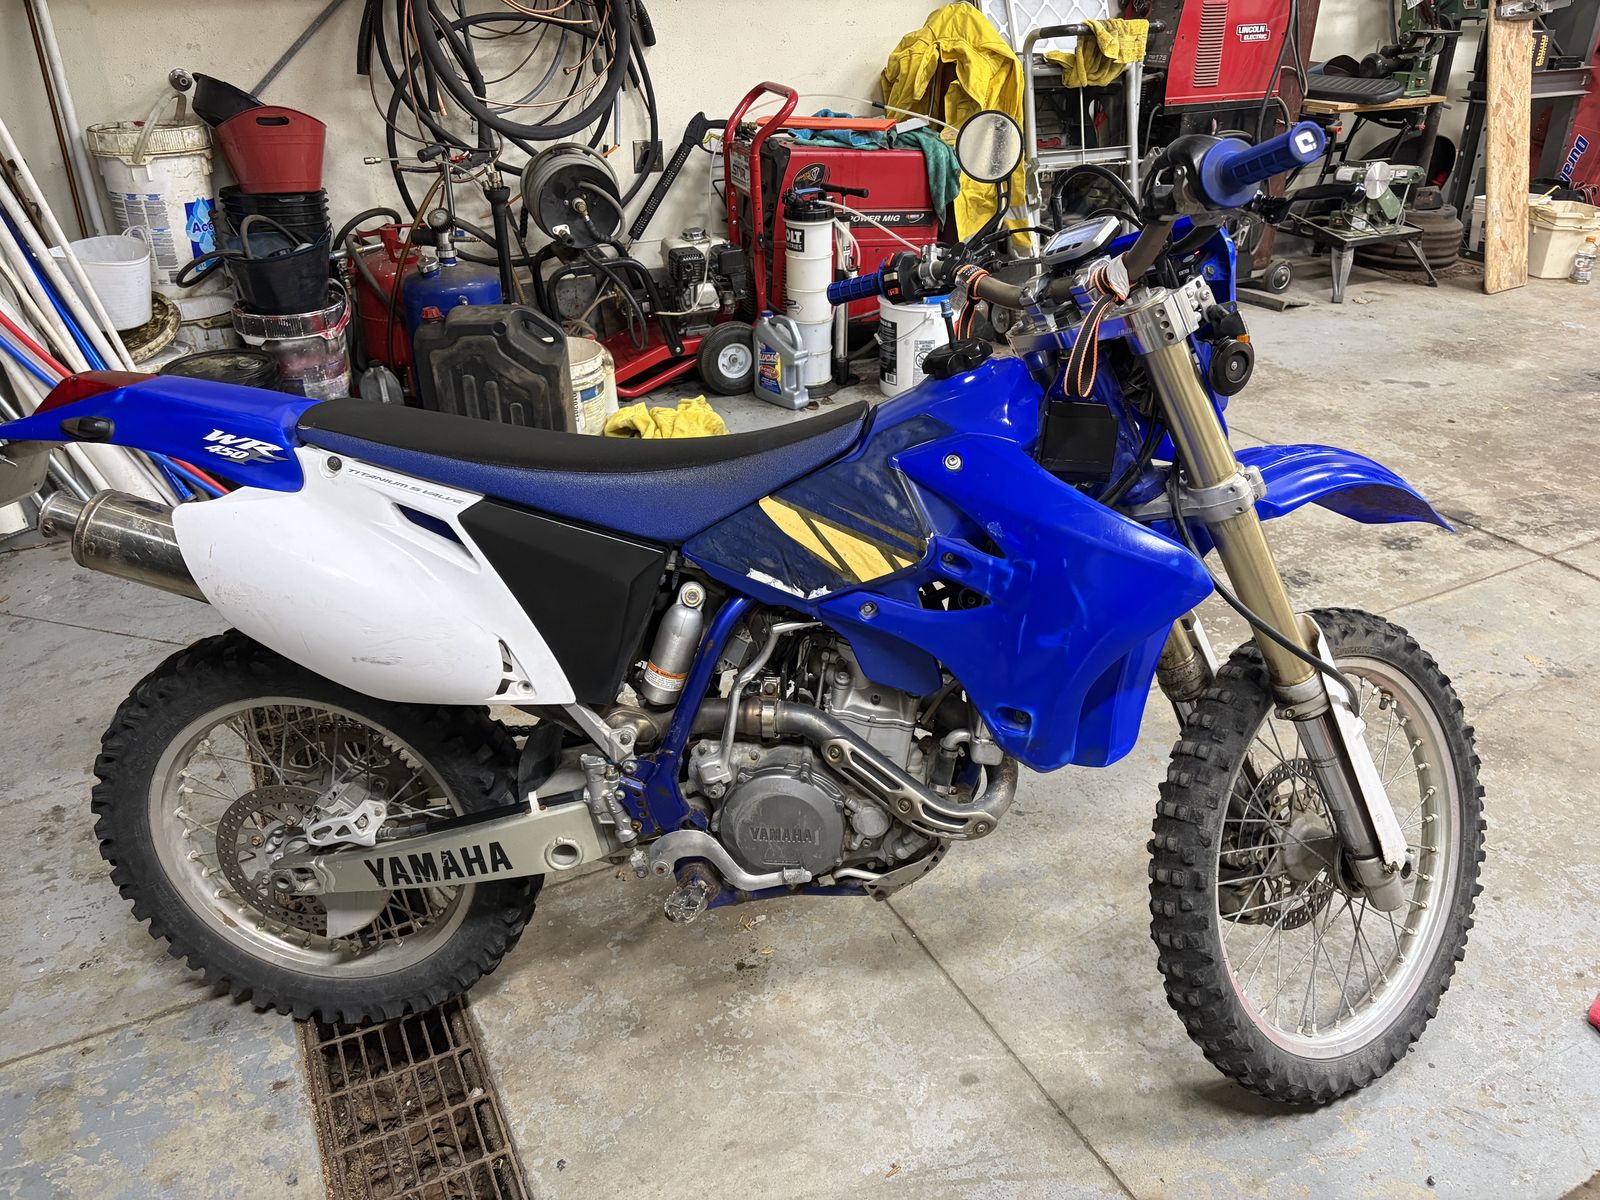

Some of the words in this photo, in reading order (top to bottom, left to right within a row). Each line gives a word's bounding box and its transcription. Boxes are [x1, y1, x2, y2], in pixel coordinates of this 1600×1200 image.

[1238, 25, 1266, 34] LINCOLN
[882, 214, 901, 222] MIG
[203, 428, 285, 457] WR
[348, 468, 409, 489] TITANIUM
[422, 489, 465, 504] VALVE
[750, 827, 812, 842] YAMAHA
[363, 841, 514, 888] YAMAHA
